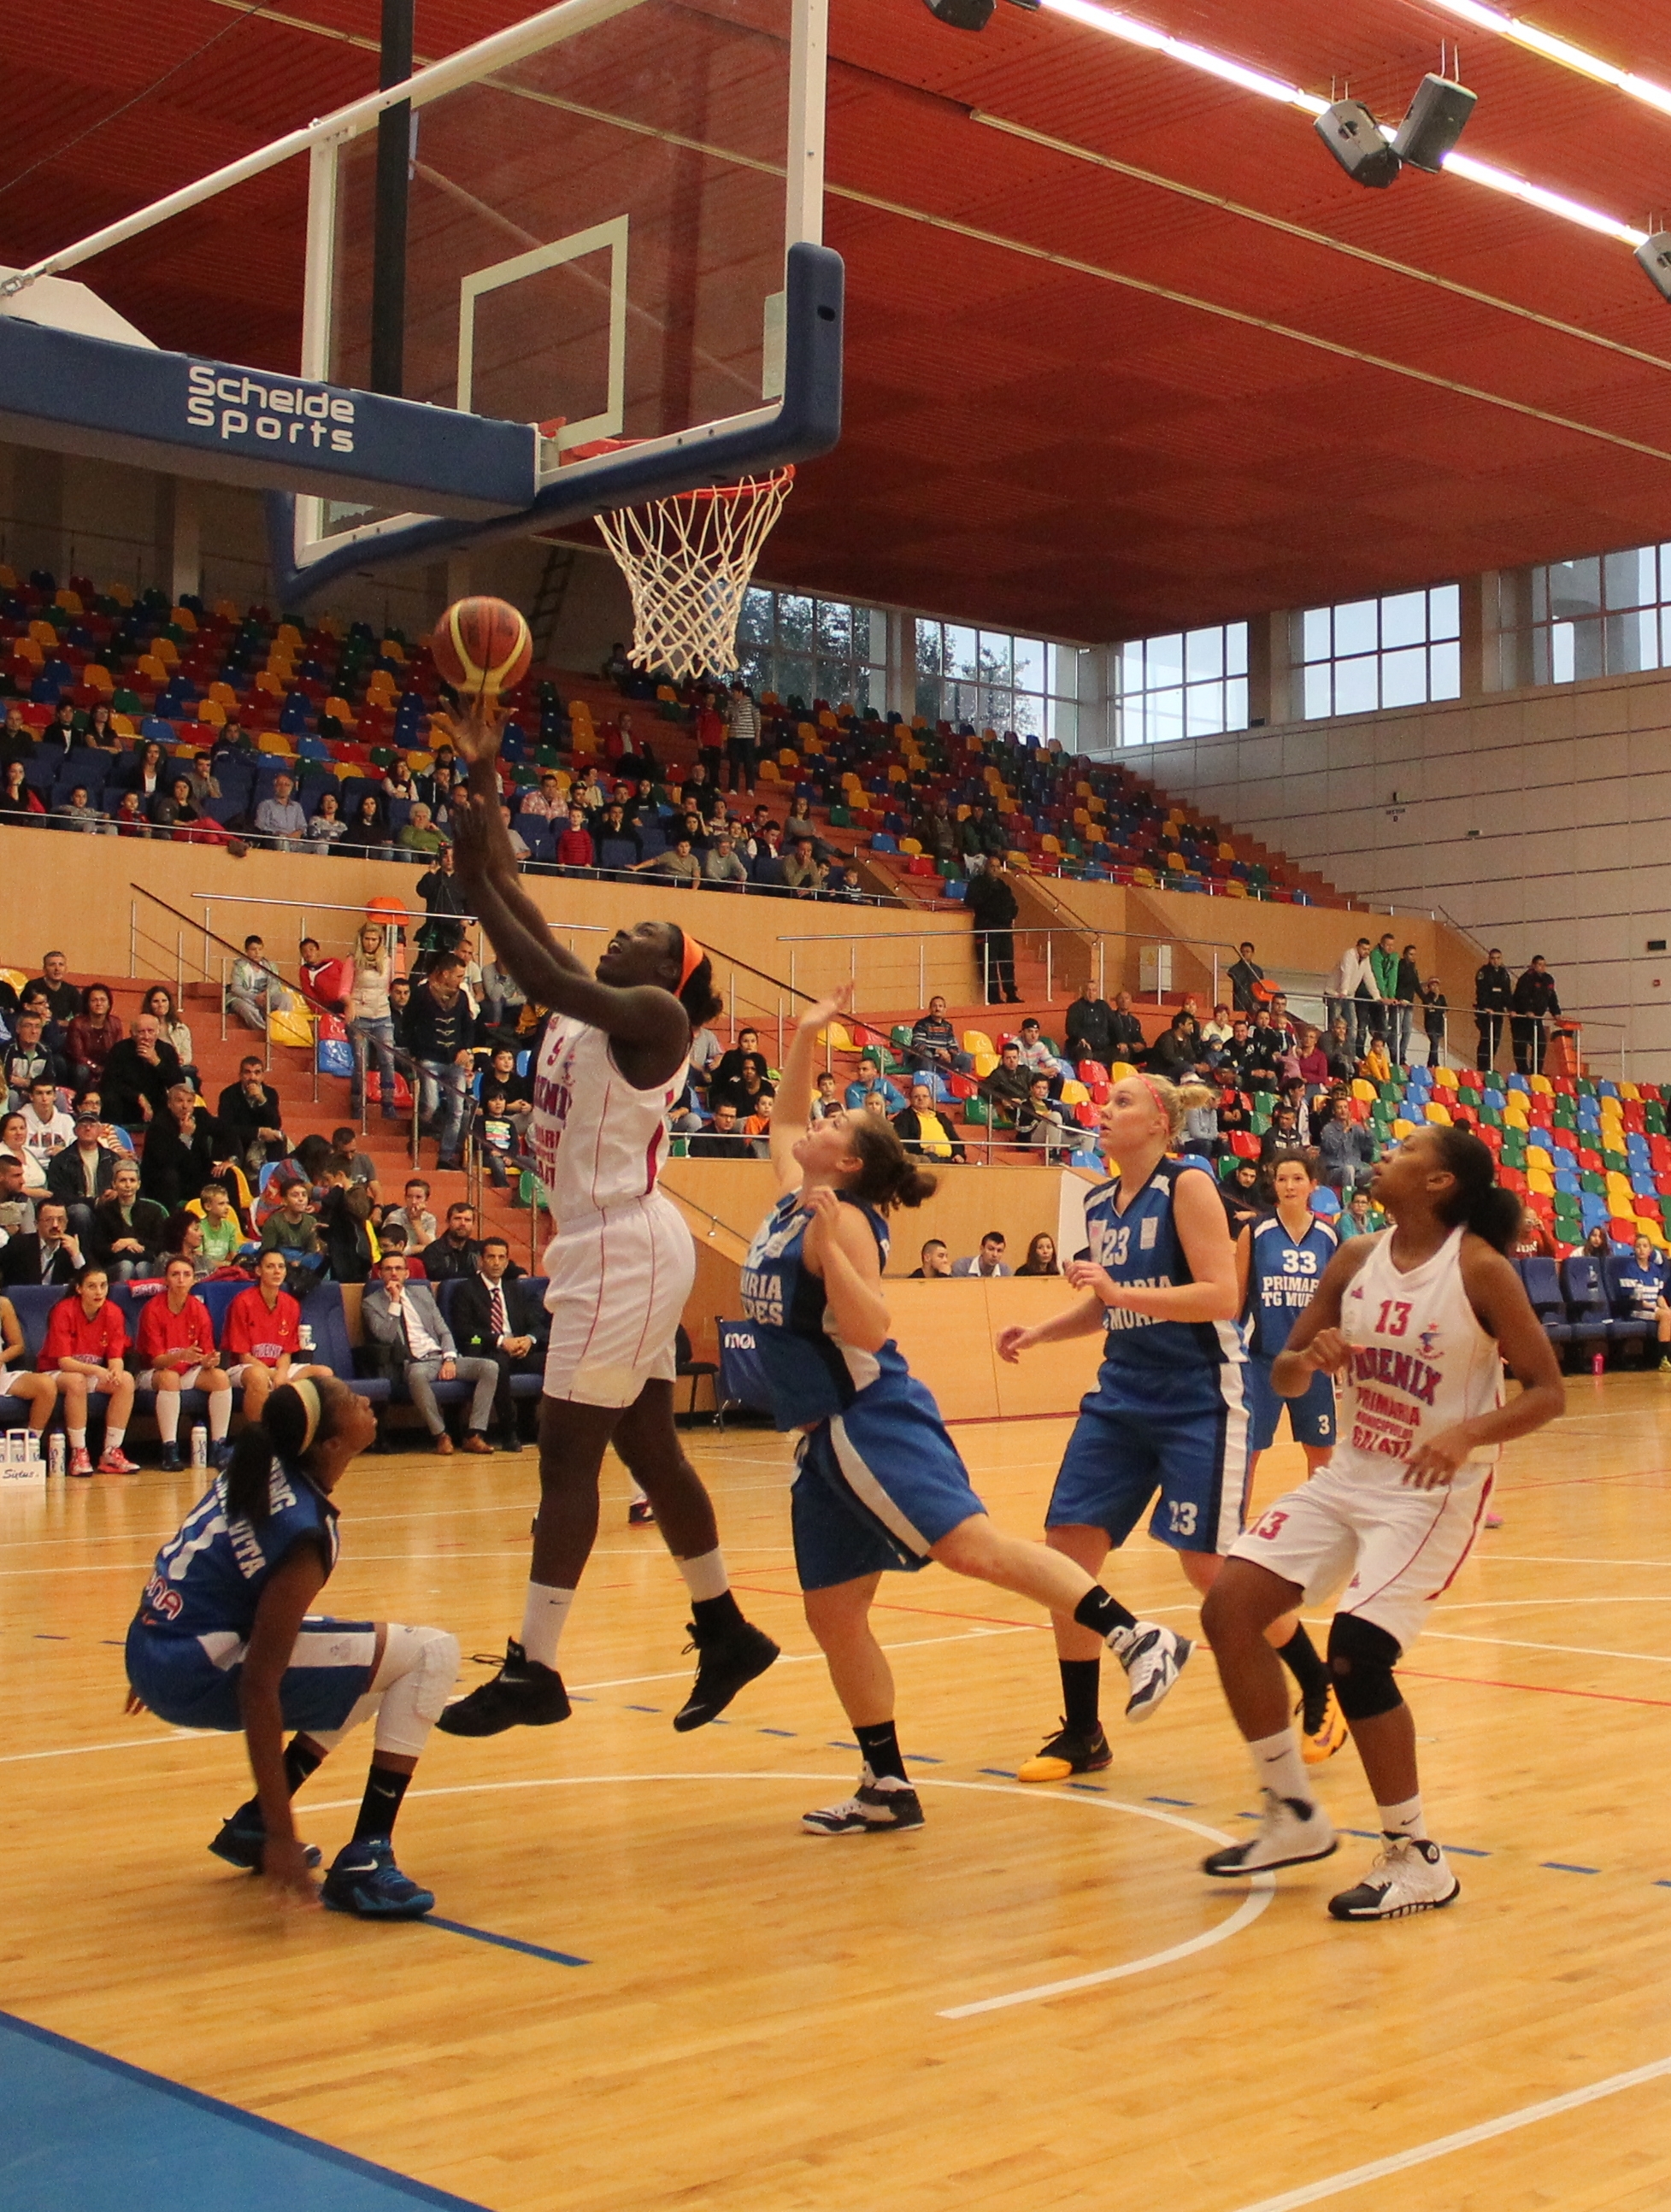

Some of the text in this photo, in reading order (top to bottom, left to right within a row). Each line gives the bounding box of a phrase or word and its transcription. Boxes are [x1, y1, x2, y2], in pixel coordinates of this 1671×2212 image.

[187, 365, 355, 424] Schelde
[186, 396, 354, 453] Sports
[1102, 1227, 1131, 1267] 23
[1282, 1249, 1317, 1274] 33
[1261, 1291, 1282, 1308] TG
[1375, 1299, 1413, 1337] 13
[1318, 1414, 1331, 1435] 3
